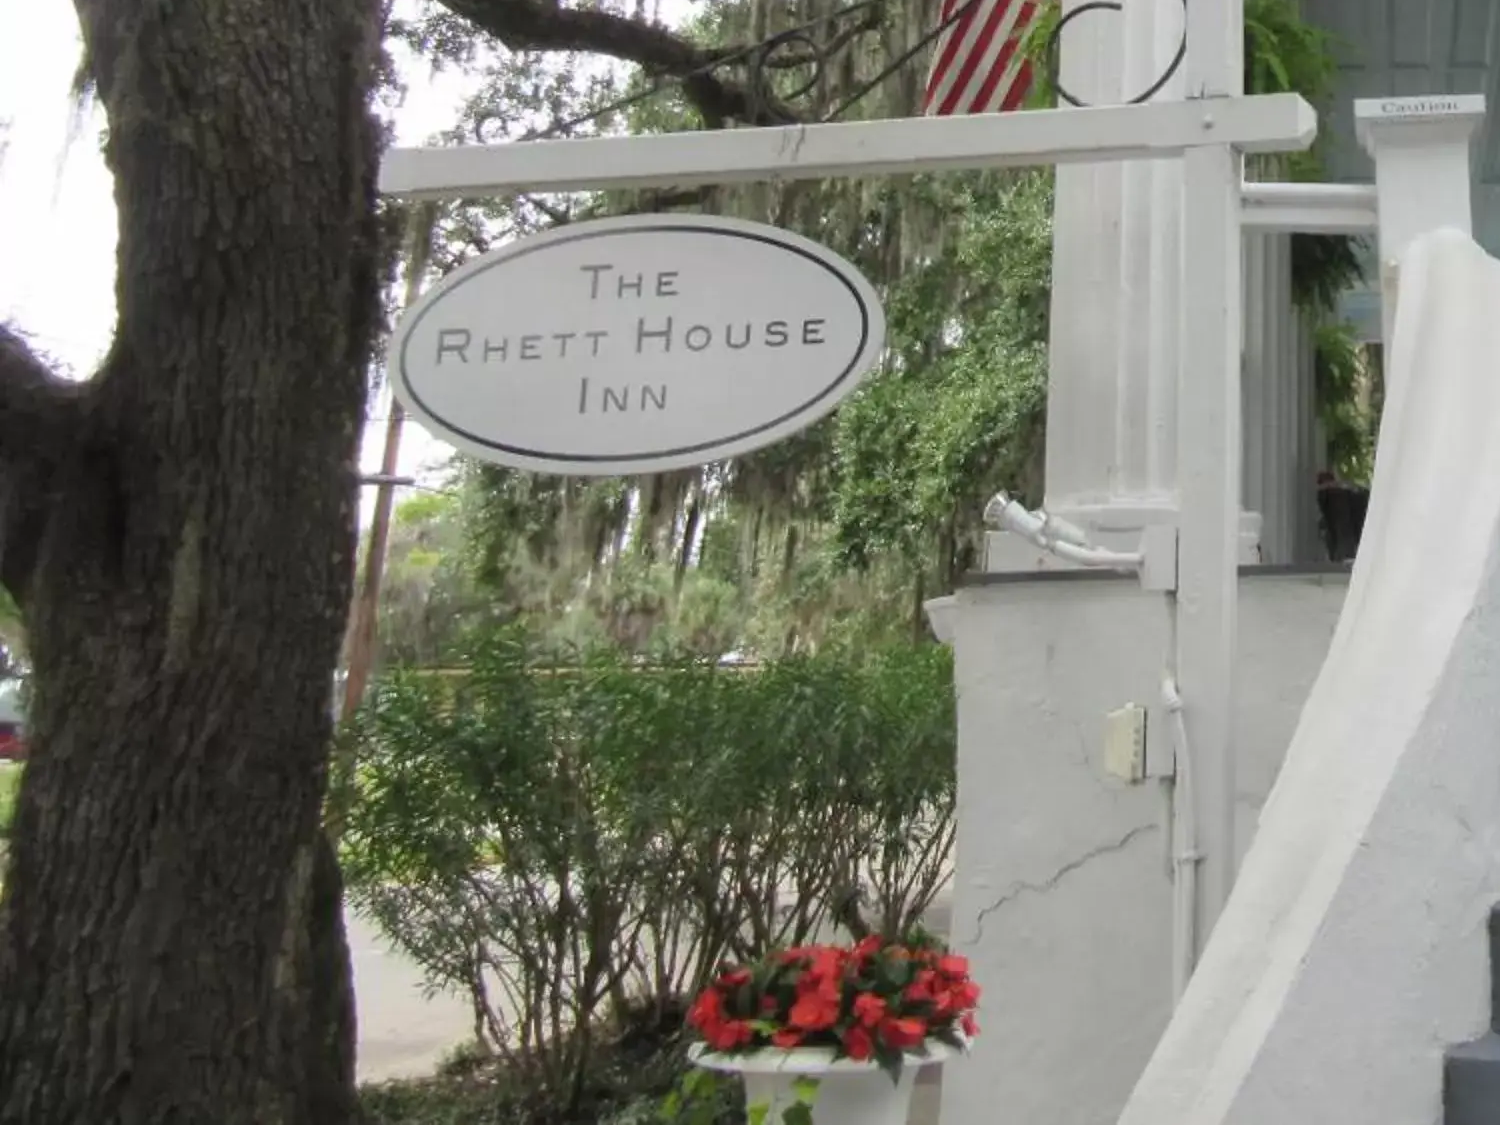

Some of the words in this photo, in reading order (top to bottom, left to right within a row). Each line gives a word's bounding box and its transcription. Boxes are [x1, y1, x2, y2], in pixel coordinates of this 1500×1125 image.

[1381, 101, 1460, 114] Caution
[581, 265, 679, 300] THE
[435, 328, 609, 365] RHETT
[634, 316, 827, 353] HOUSE
[578, 376, 667, 414] INN
